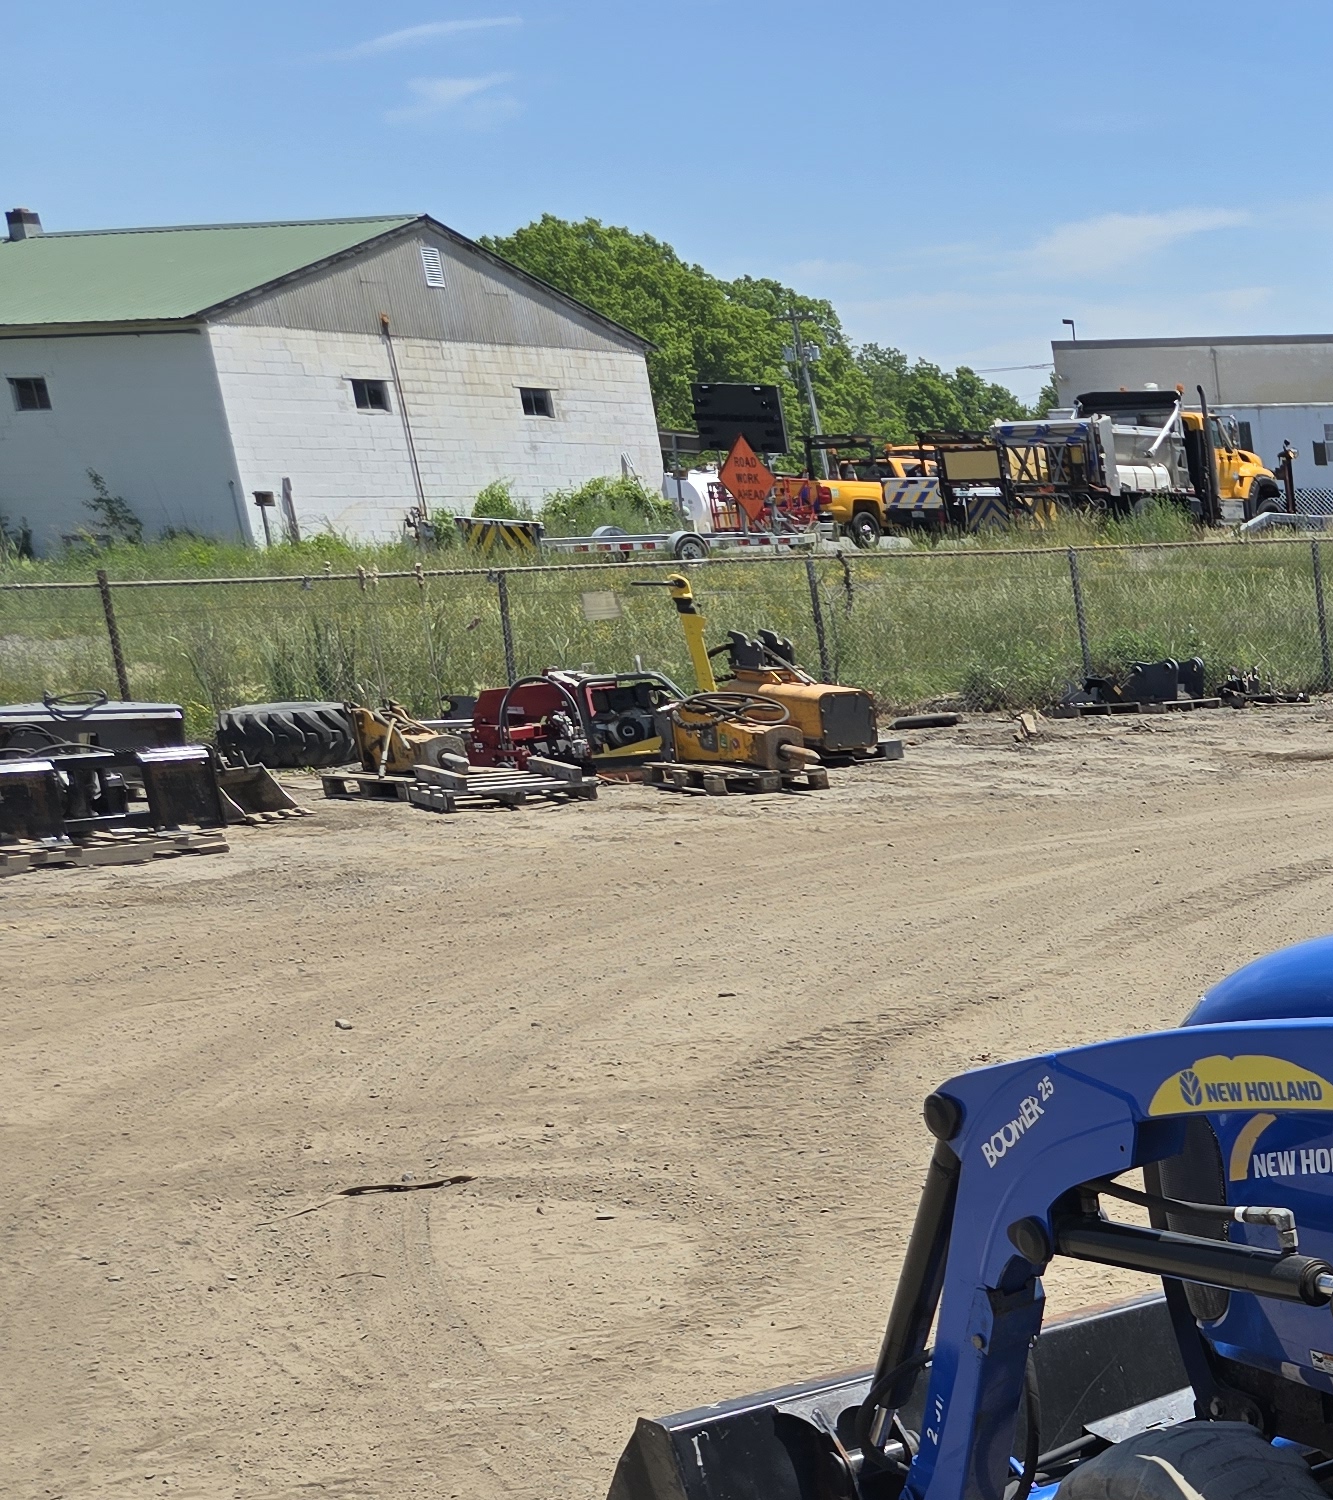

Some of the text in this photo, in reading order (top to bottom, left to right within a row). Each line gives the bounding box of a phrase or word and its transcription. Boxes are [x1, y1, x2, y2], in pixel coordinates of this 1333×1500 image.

[733, 457, 756, 468] ROAD
[735, 473, 760, 484] WORK
[737, 490, 765, 500] AHEAD
[1205, 1081, 1323, 1102] NEW HOLLAND
[981, 1075, 1054, 1169] BOOMER 25
[1253, 1150, 1296, 1178] NEW
